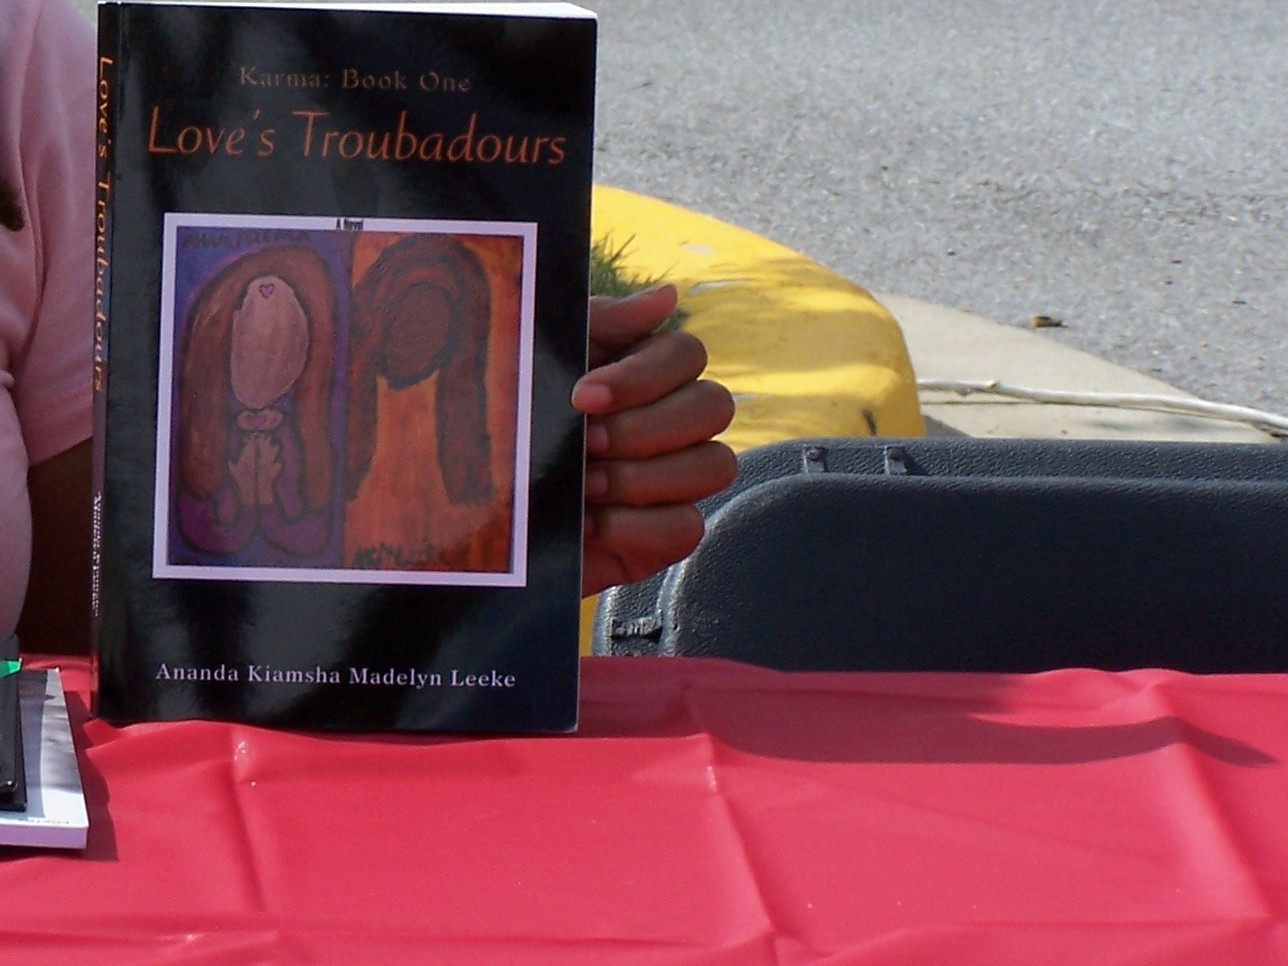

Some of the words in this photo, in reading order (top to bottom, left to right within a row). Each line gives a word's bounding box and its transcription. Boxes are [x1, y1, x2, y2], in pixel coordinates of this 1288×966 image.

[239, 66, 330, 89] Karma:
[341, 68, 408, 91] Book
[418, 70, 472, 93] One
[98, 57, 113, 157] Love's
[147, 105, 276, 157] Love's
[291, 109, 567, 165] Troubadours
[155, 663, 239, 683] Ananda
[248, 664, 341, 684] Kiamsha
[349, 667, 442, 689] Madelyn
[450, 669, 516, 687] Leeke
